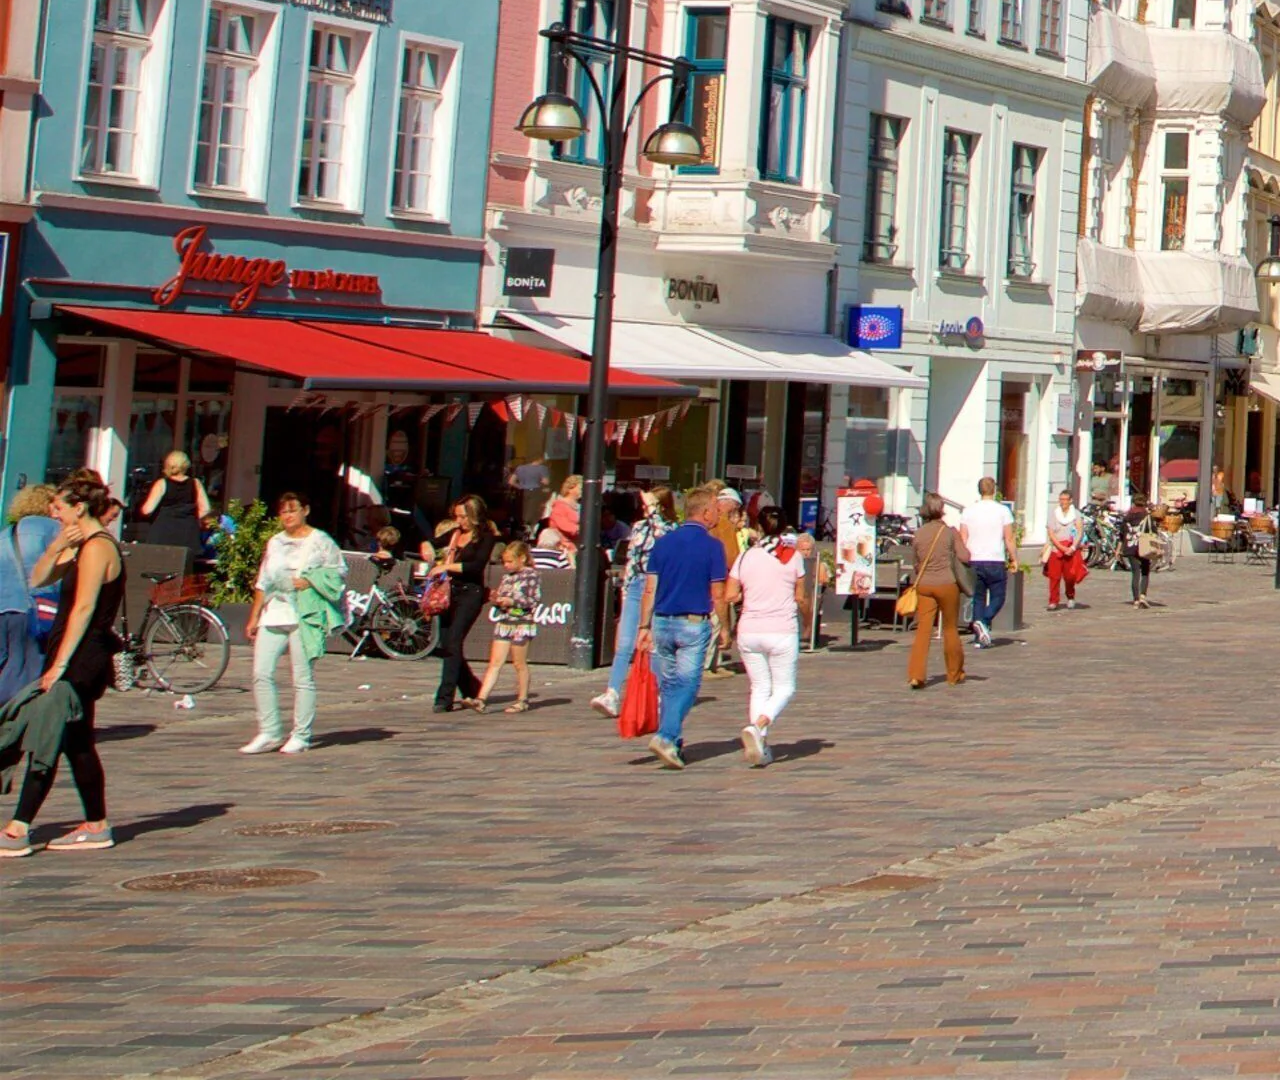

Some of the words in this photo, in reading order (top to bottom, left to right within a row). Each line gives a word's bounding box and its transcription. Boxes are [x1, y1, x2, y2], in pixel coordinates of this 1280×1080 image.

[153, 225, 286, 311] Junge
[506, 276, 547, 290] BONITA
[667, 276, 720, 306] BONITA
